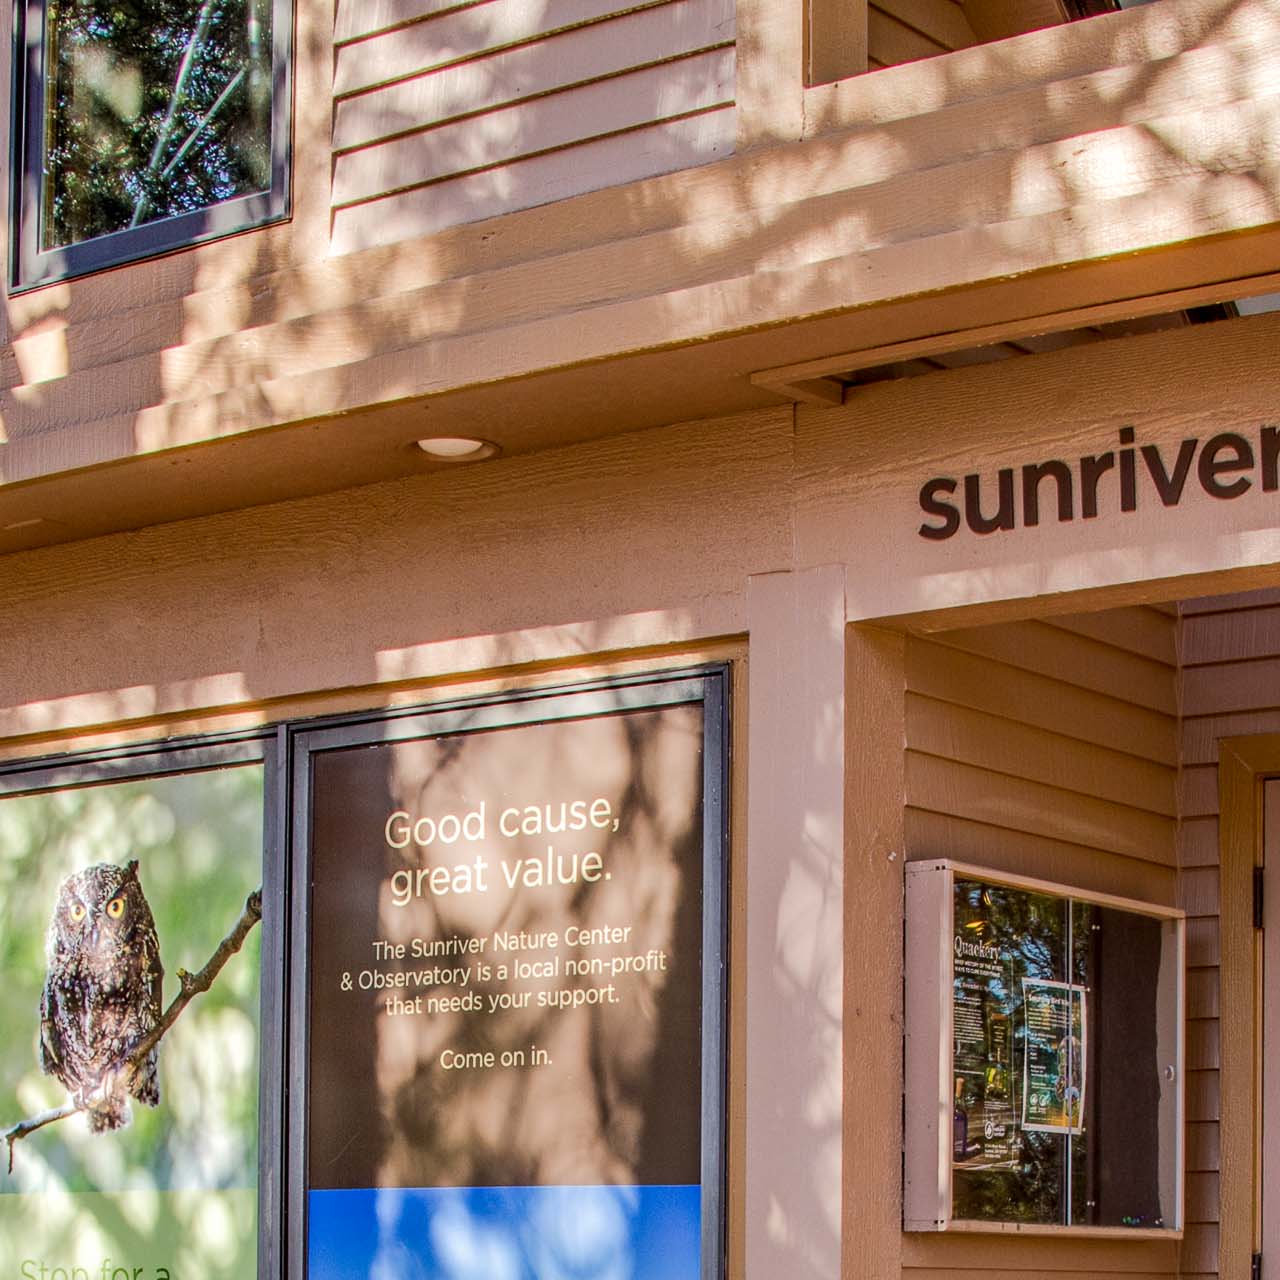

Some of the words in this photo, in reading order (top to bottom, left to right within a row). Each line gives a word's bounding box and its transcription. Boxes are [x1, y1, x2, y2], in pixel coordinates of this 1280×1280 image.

[385, 801, 486, 848] Good
[499, 798, 620, 837] cause,
[391, 855, 488, 906] great
[501, 846, 612, 888] value.
[373, 941, 406, 960] The
[411, 937, 486, 958] Sunriver
[493, 930, 559, 952] Nature
[565, 925, 631, 946] Center
[340, 972, 353, 991] &
[359, 963, 471, 990] Observatory
[477, 962, 491, 981] is
[497, 966, 508, 980] a
[514, 957, 559, 979] local
[565, 950, 667, 977] non-profit
[385, 996, 422, 1016] that
[427, 991, 483, 1013] needs
[488, 991, 531, 1014] your
[537, 983, 620, 1009] support.
[440, 1050, 495, 1070] Come
[501, 1050, 525, 1066] on
[531, 1045, 552, 1066] in.
